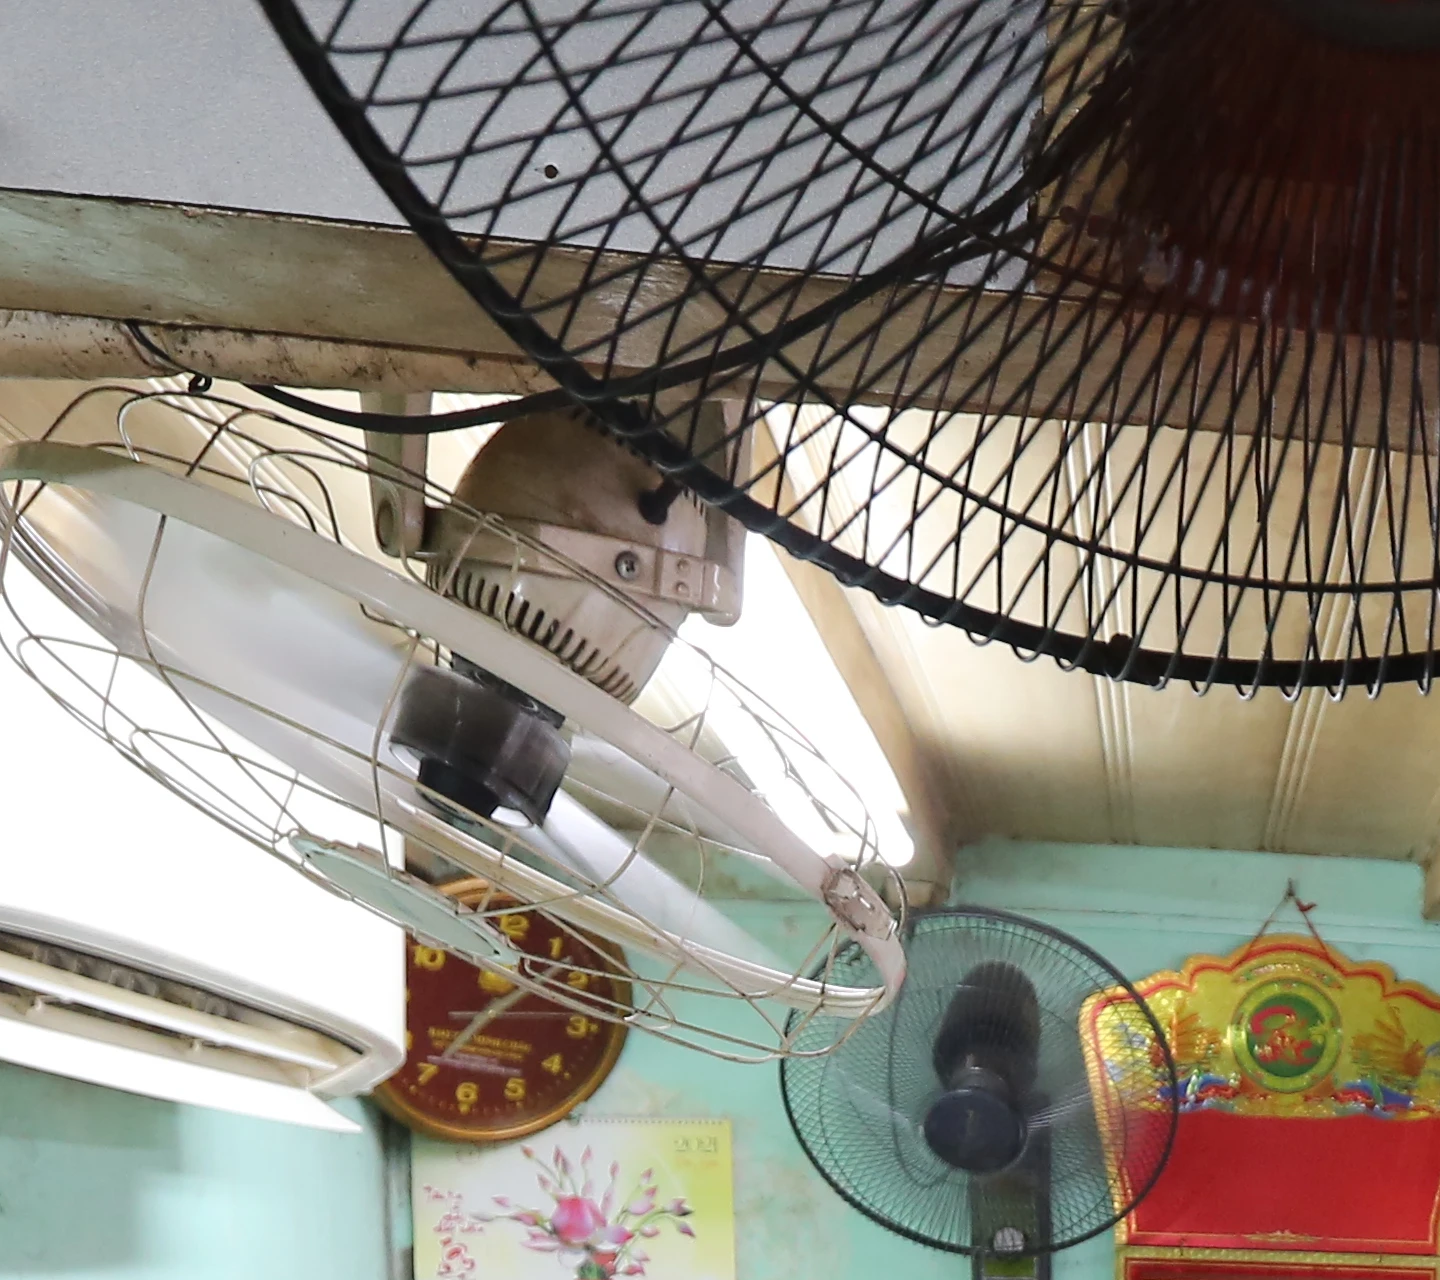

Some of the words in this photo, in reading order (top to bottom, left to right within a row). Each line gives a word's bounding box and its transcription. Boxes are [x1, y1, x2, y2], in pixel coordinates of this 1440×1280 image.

[414, 945, 446, 971] 10
[549, 937, 564, 959] 1
[568, 971, 589, 989] 2
[566, 1016, 588, 1039] 3
[417, 1063, 438, 1085] 7
[541, 1054, 561, 1075] 4
[456, 1082, 479, 1104] 6
[505, 1078, 526, 1100] 5
